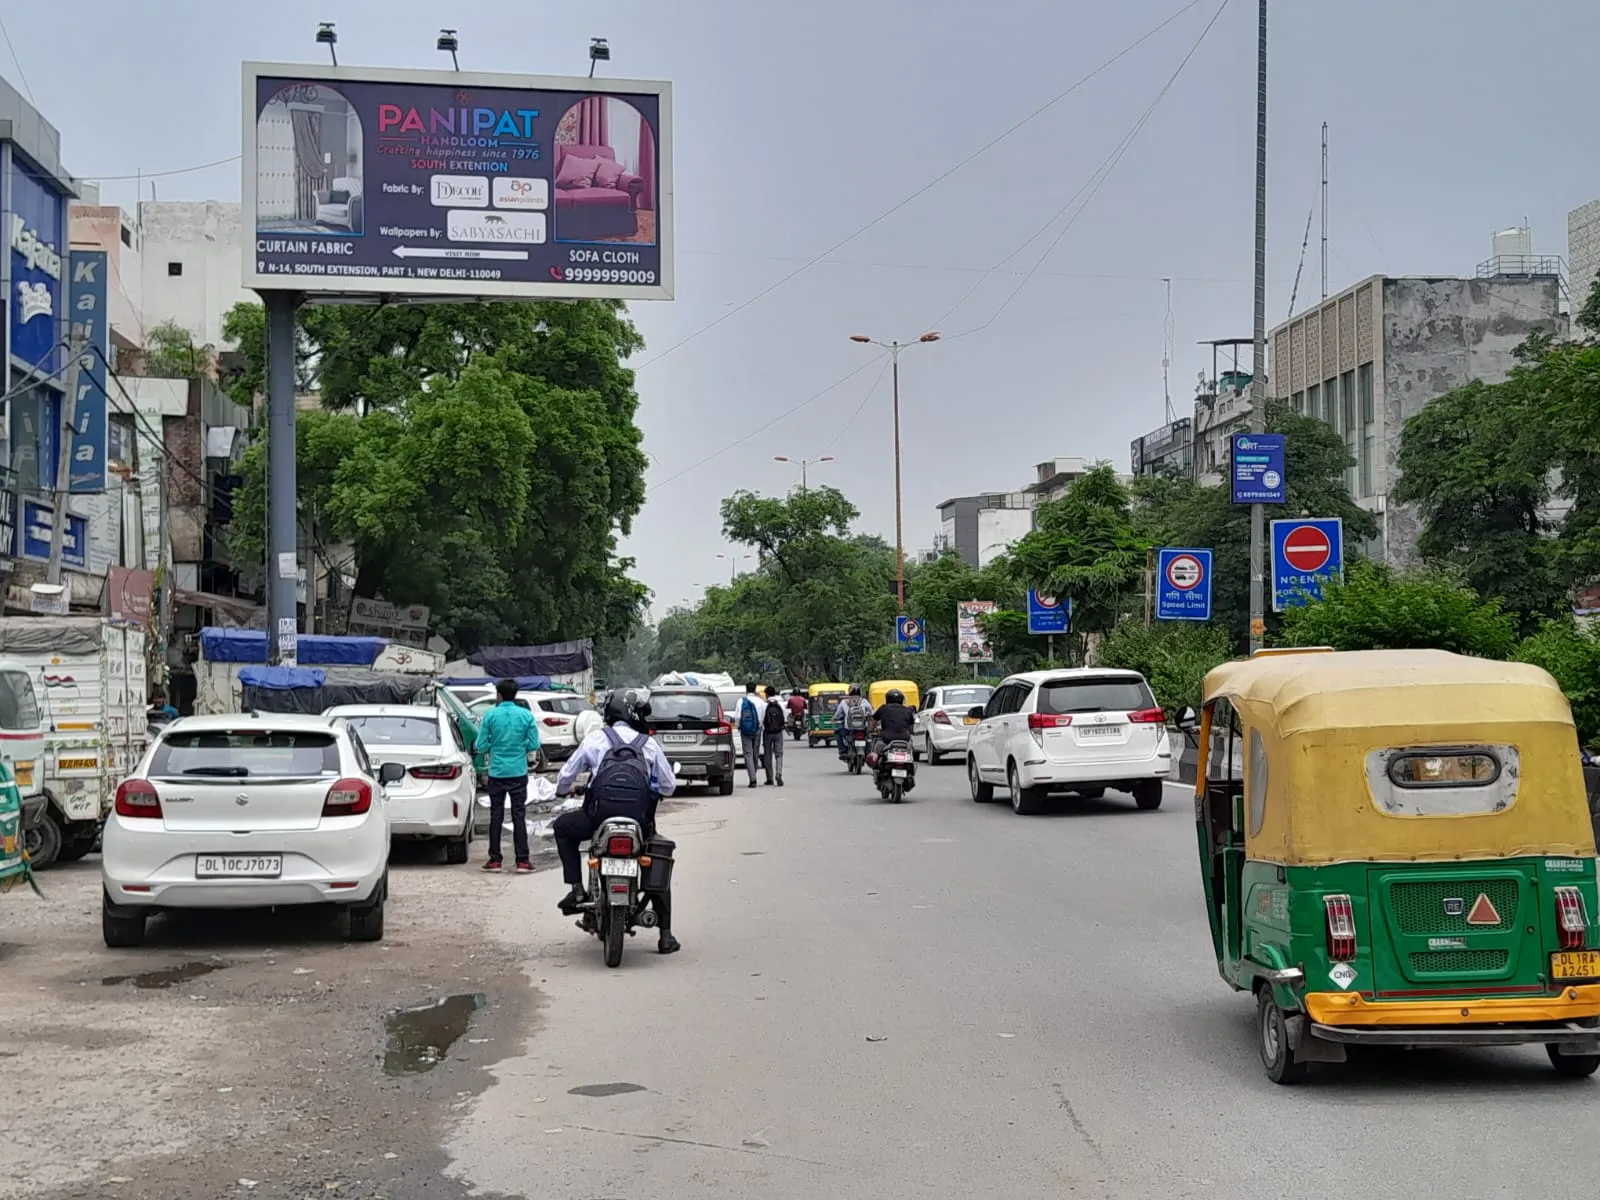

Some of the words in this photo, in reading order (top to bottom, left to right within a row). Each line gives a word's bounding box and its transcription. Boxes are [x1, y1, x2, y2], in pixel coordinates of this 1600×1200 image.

[378, 104, 539, 137] PANIPAT
[421, 136, 498, 148] HANDLOOM
[376, 144, 420, 158] Crafting
[426, 147, 476, 159] happiness
[482, 147, 507, 159] since
[512, 149, 540, 160] 1976
[411, 159, 446, 170] SOUTH
[450, 161, 508, 172] EXTENTION
[382, 183, 409, 193] Fabric
[379, 226, 428, 238] Wallpapers
[451, 227, 540, 241] SABYASACHI
[256, 240, 308, 253] CURTAIN
[311, 241, 354, 255] FABRIC
[569, 249, 600, 263] SOFA
[602, 250, 639, 264] CLOTH
[268, 263, 292, 275] N-14,
[294, 264, 325, 274] SOUTH
[327, 265, 380, 277] EXTENSION,
[382, 266, 405, 276] PART
[417, 267, 437, 277] NEW
[439, 268, 502, 279] DELHI-110049
[565, 268, 656, 284] 9999999009
[1280, 575, 1297, 585] NO
[1161, 600, 1185, 609] Speed
[1187, 601, 1205, 609] Limit
